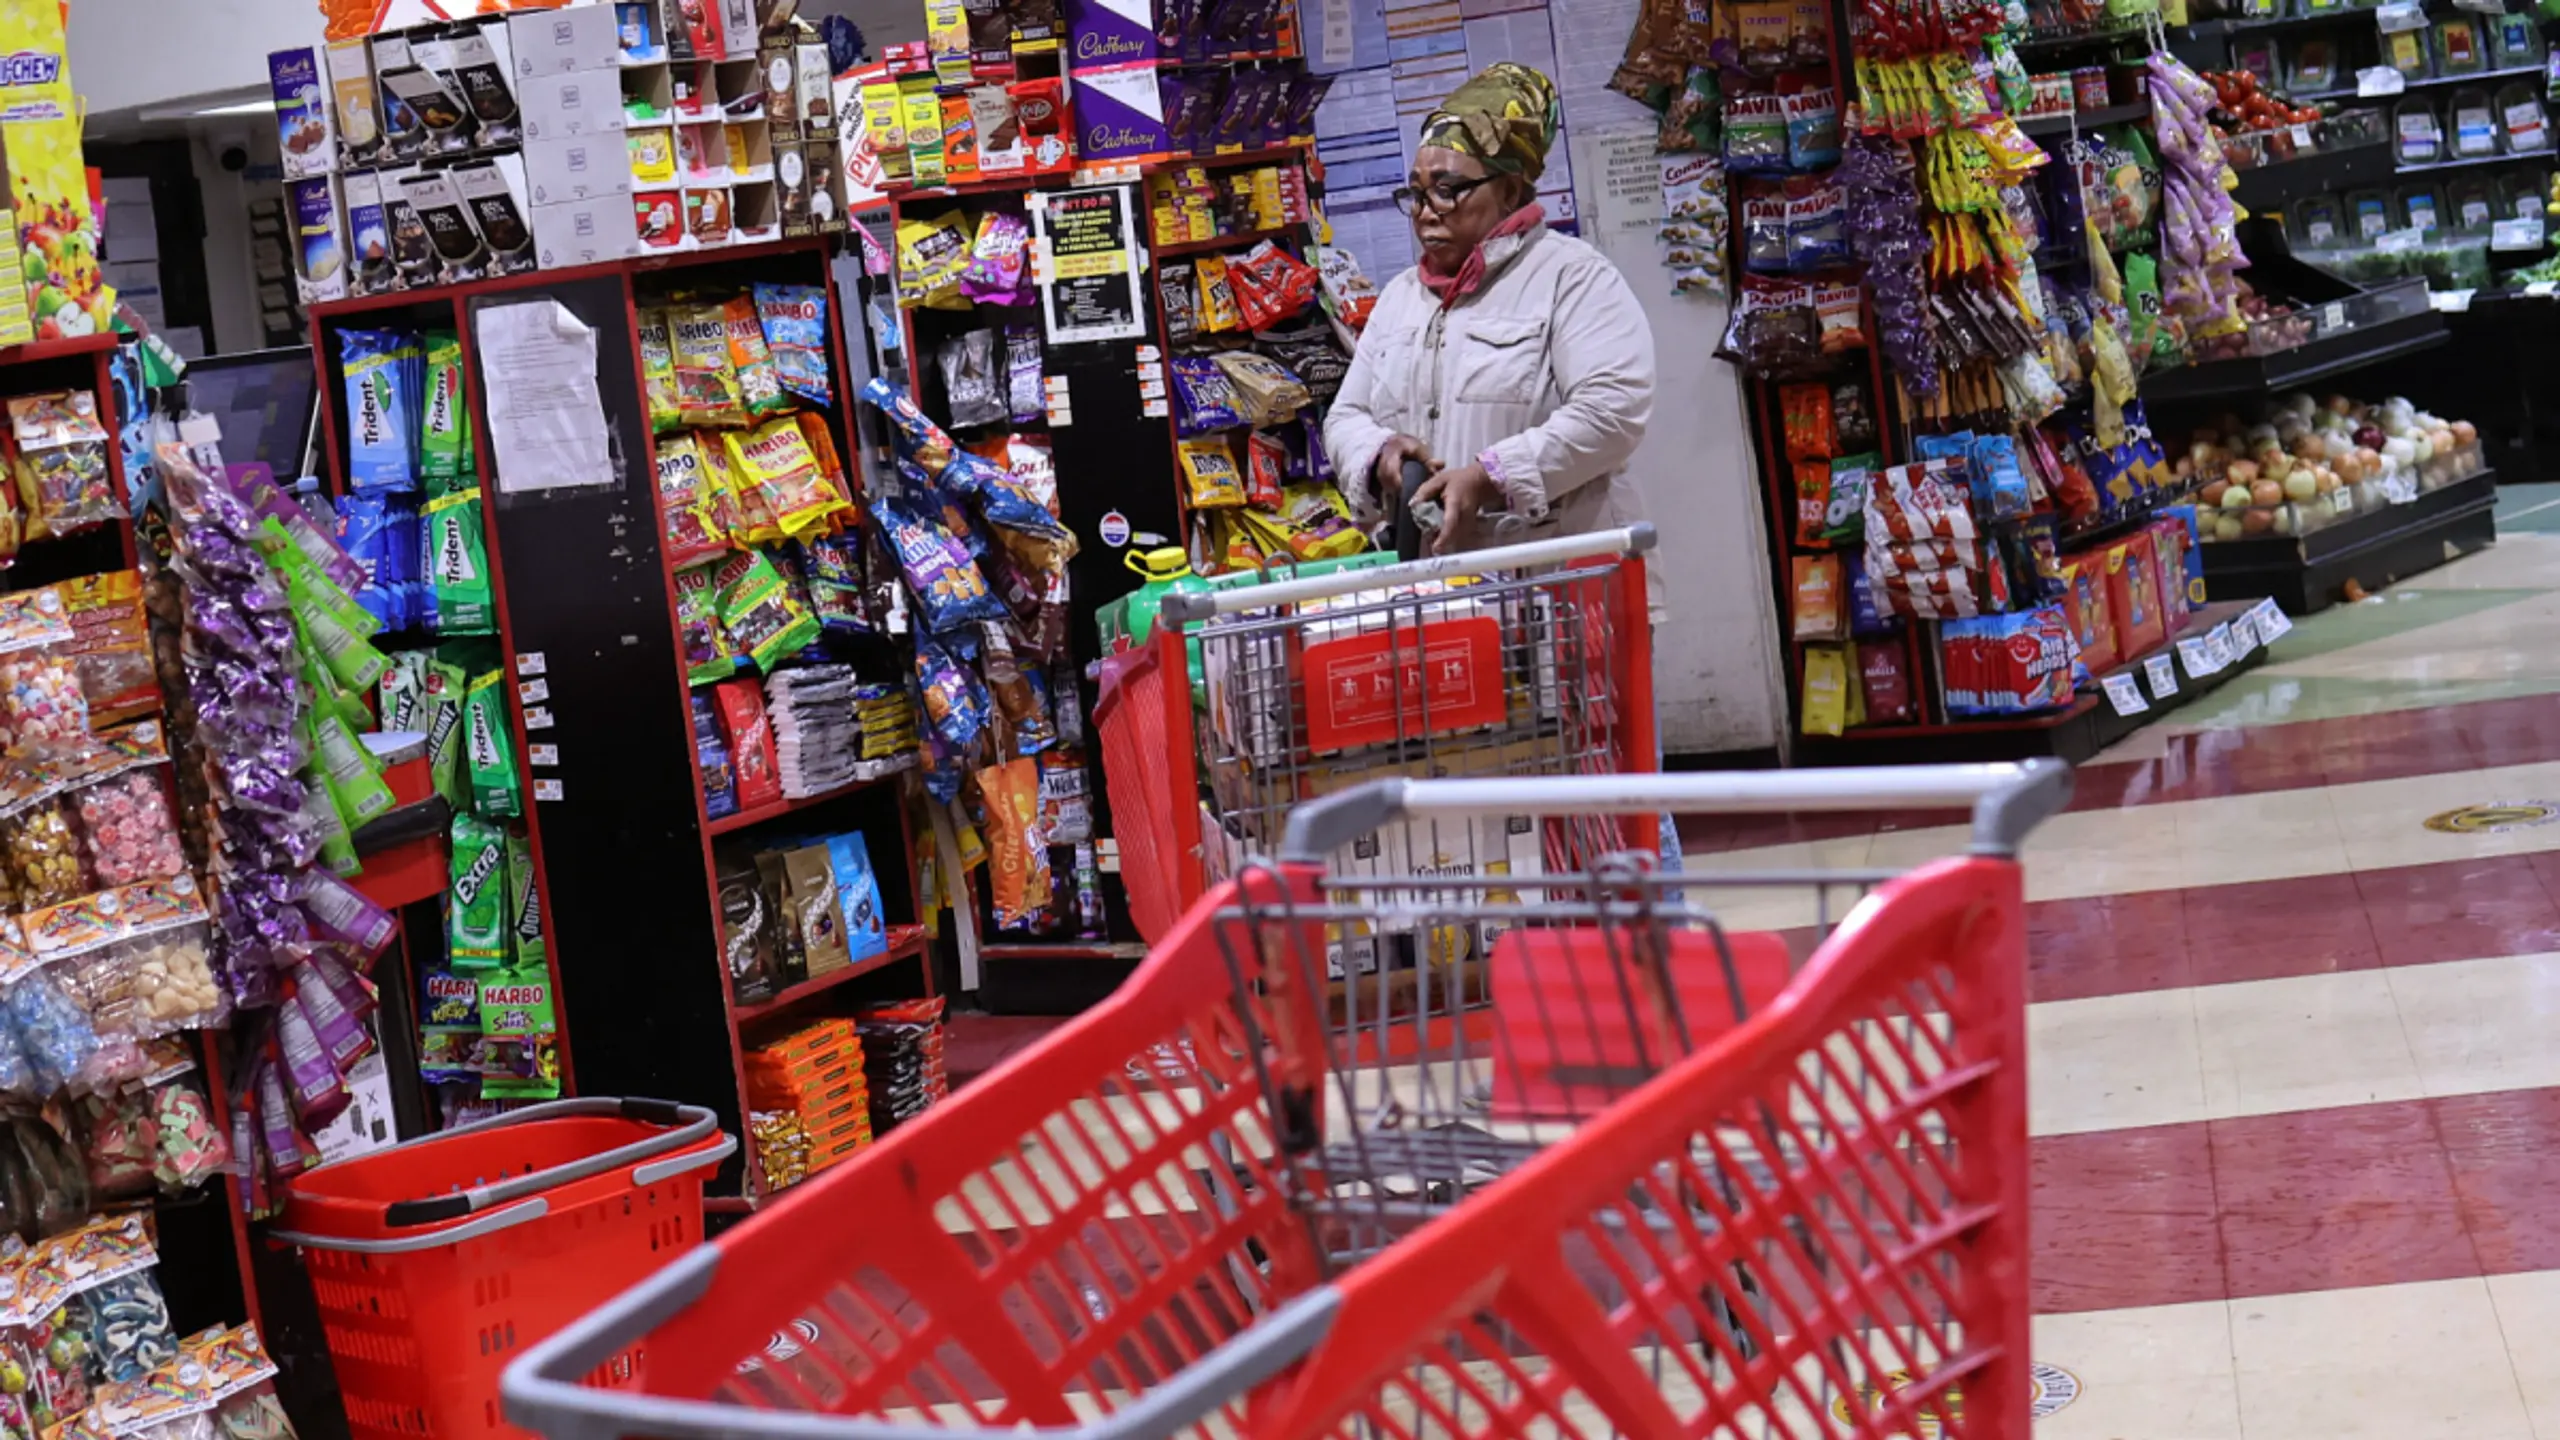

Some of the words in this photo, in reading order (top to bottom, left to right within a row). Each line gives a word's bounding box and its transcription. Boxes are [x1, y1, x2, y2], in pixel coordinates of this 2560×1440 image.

[1077, 32, 1145, 60] Cadbury
[1088, 124, 1156, 153] Cadbury
[1750, 201, 1786, 218] DAV
[1816, 288, 1858, 305] DAVID
[360, 379, 379, 447] Trident
[431, 369, 449, 437] Trident
[741, 430, 801, 460] HARIBO
[445, 516, 461, 587] Trident
[714, 550, 761, 594] ARIBO
[2039, 635, 2066, 659] AIR
[2026, 654, 2068, 679] HEADS
[471, 702, 489, 771] Trident
[455, 843, 499, 905] Extra
[1413, 862, 1473, 878] Corona
